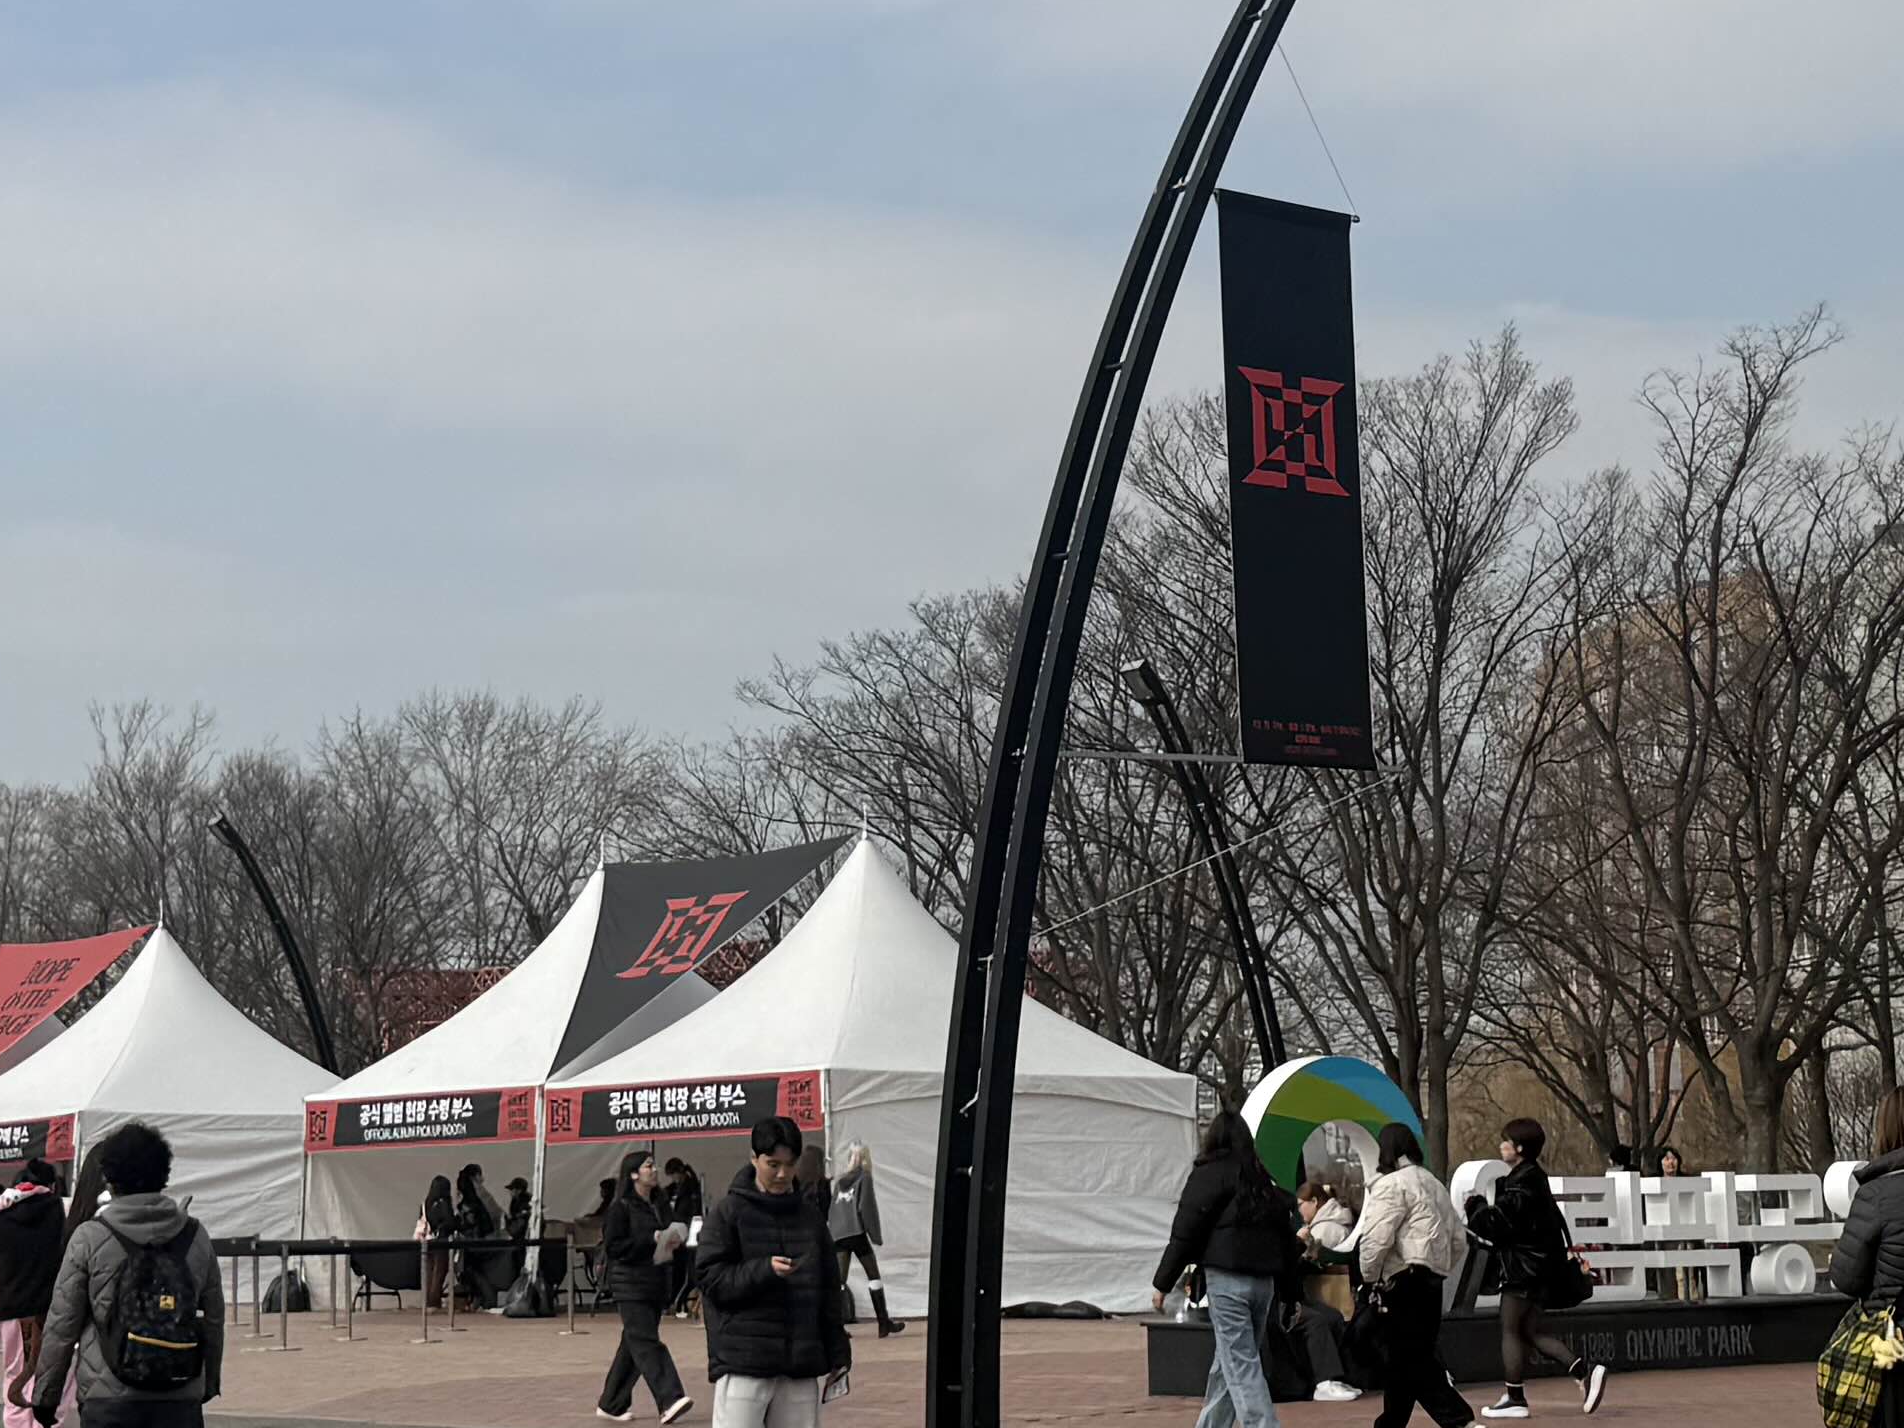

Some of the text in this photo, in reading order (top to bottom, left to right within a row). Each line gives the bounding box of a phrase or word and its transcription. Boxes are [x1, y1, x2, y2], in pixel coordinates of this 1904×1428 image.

[719, 1082, 747, 1108] 부스
[1626, 1326, 1704, 1361] OLYMPIC
[1707, 1323, 1755, 1357] PARK
